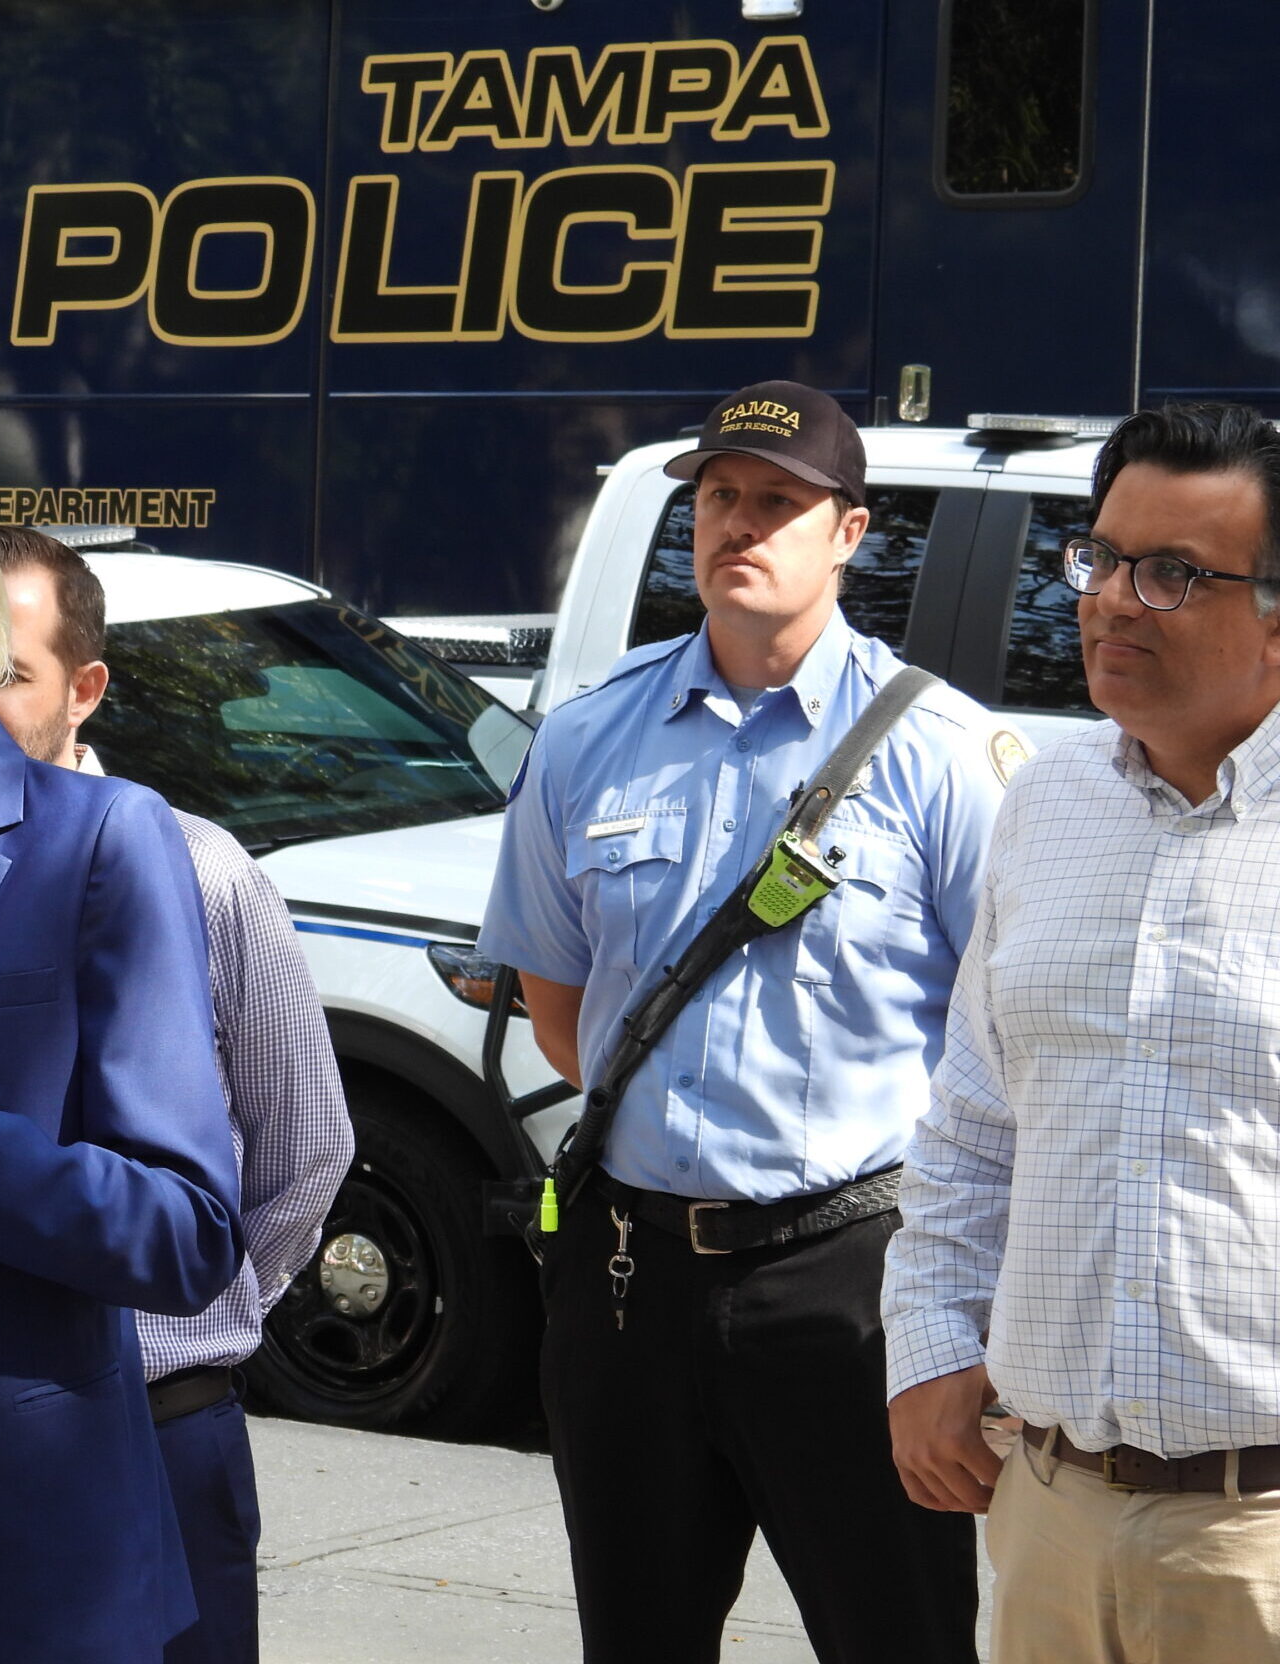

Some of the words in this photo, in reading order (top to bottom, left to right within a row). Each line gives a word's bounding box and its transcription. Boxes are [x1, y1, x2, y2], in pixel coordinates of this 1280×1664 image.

[360, 35, 830, 153] TAMPA
[10, 160, 836, 347] POLICE
[719, 422, 743, 434] FIRE
[743, 422, 793, 438] RESCUE
[721, 400, 800, 430] TAMPA
